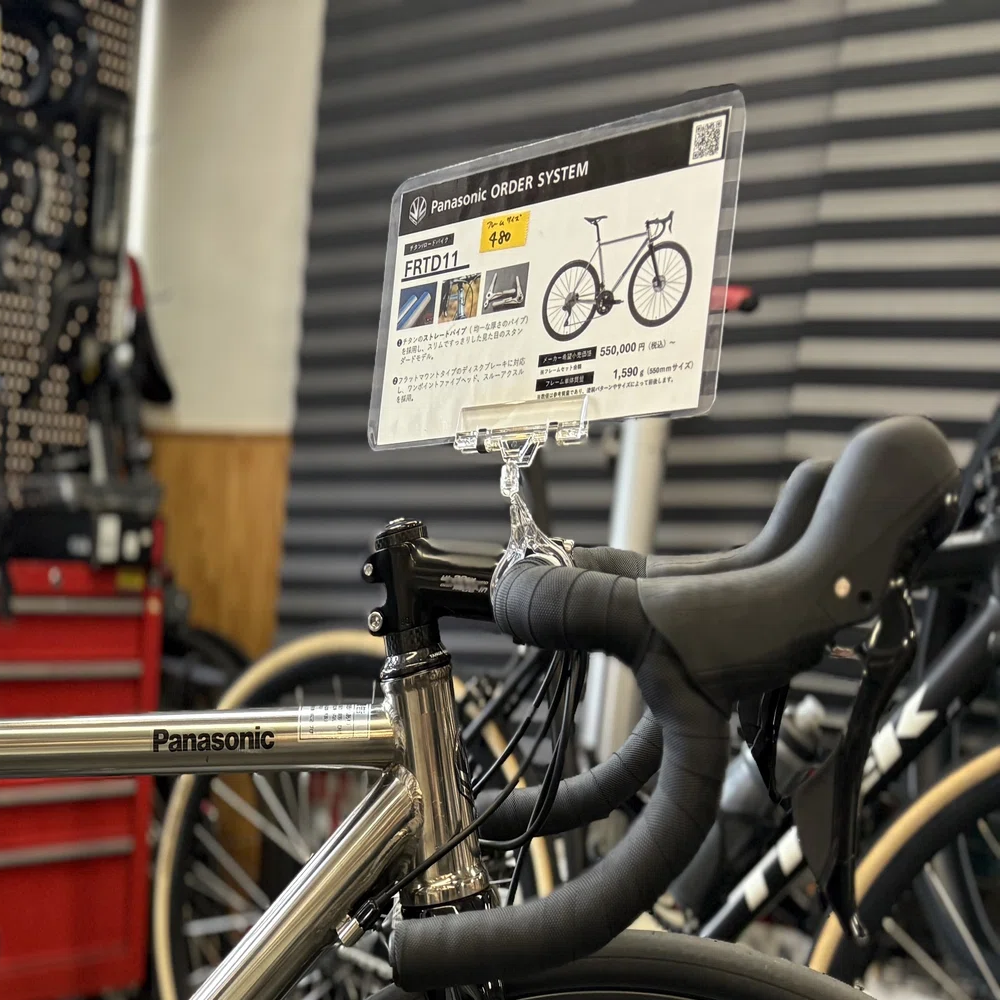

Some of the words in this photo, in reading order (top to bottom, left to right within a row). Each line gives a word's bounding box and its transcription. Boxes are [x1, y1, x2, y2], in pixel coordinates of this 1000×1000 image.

[431, 187, 487, 214] Panasonic
[490, 175, 533, 198] ORDER
[537, 160, 590, 188] SYSTEM
[488, 230, 512, 248] 480
[404, 250, 459, 278] FRTD11
[153, 725, 275, 752] Panasonic
